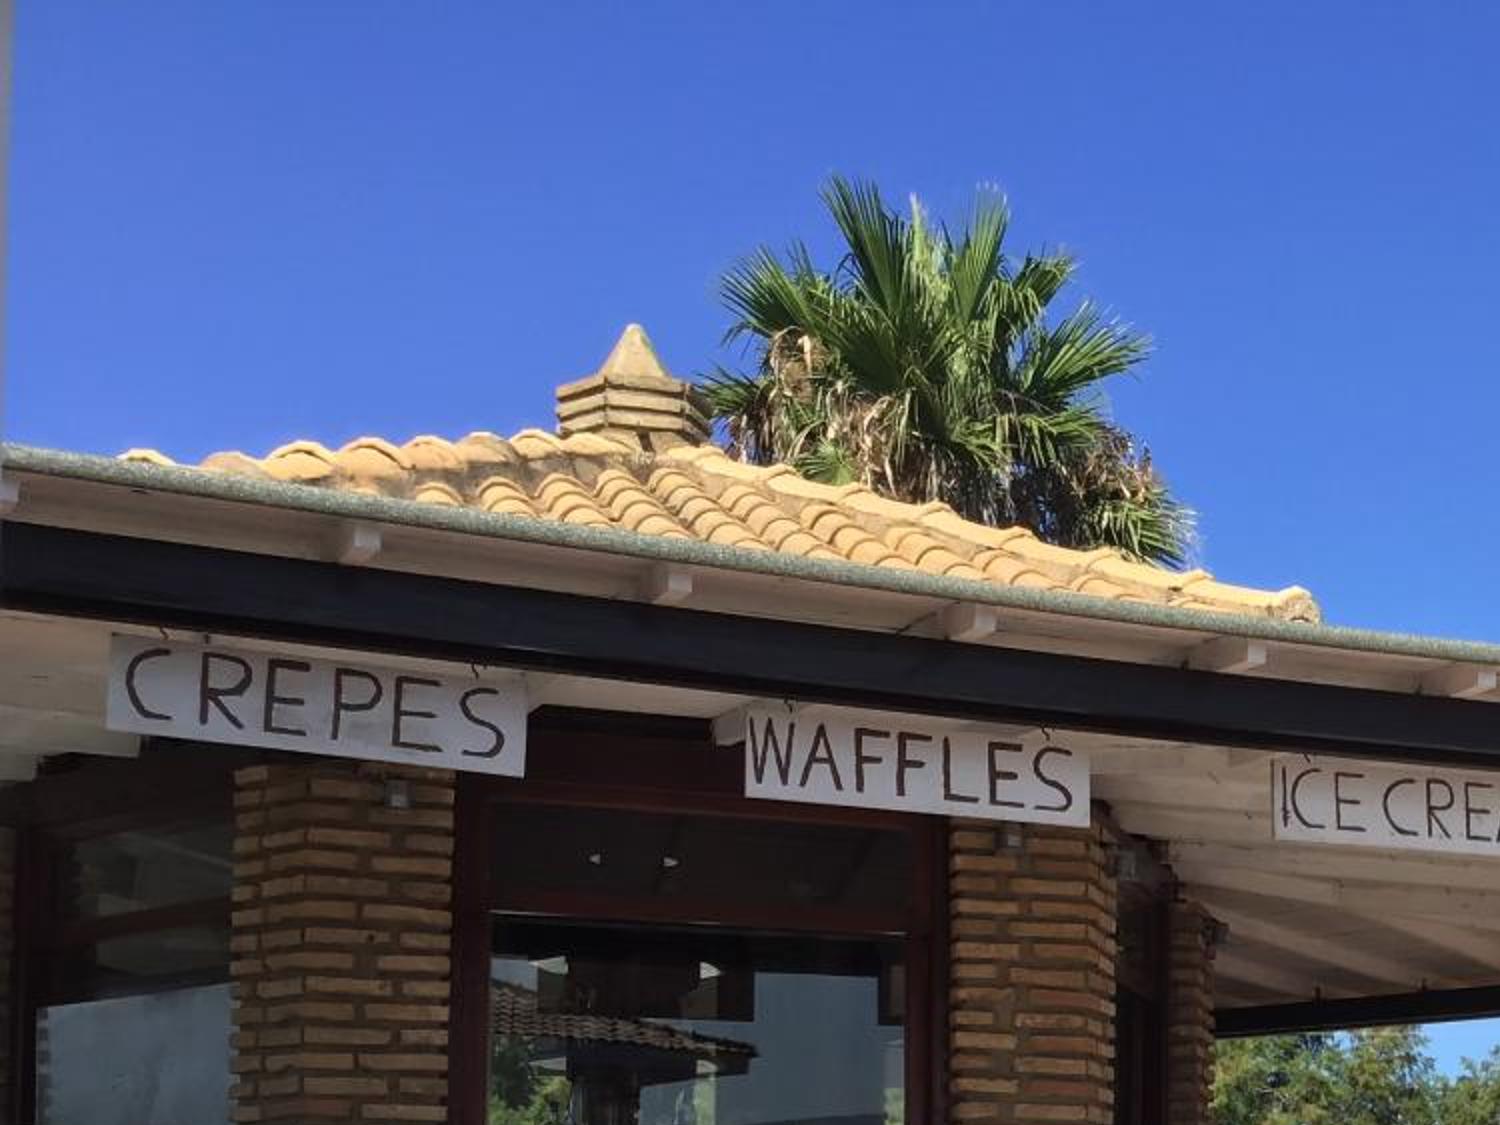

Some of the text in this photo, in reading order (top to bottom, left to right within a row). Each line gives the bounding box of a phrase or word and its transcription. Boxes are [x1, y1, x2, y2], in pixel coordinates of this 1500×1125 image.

[125, 647, 505, 758] CREPES
[749, 716, 1073, 812] WAFFLES
[1281, 765, 1367, 833] ICE
